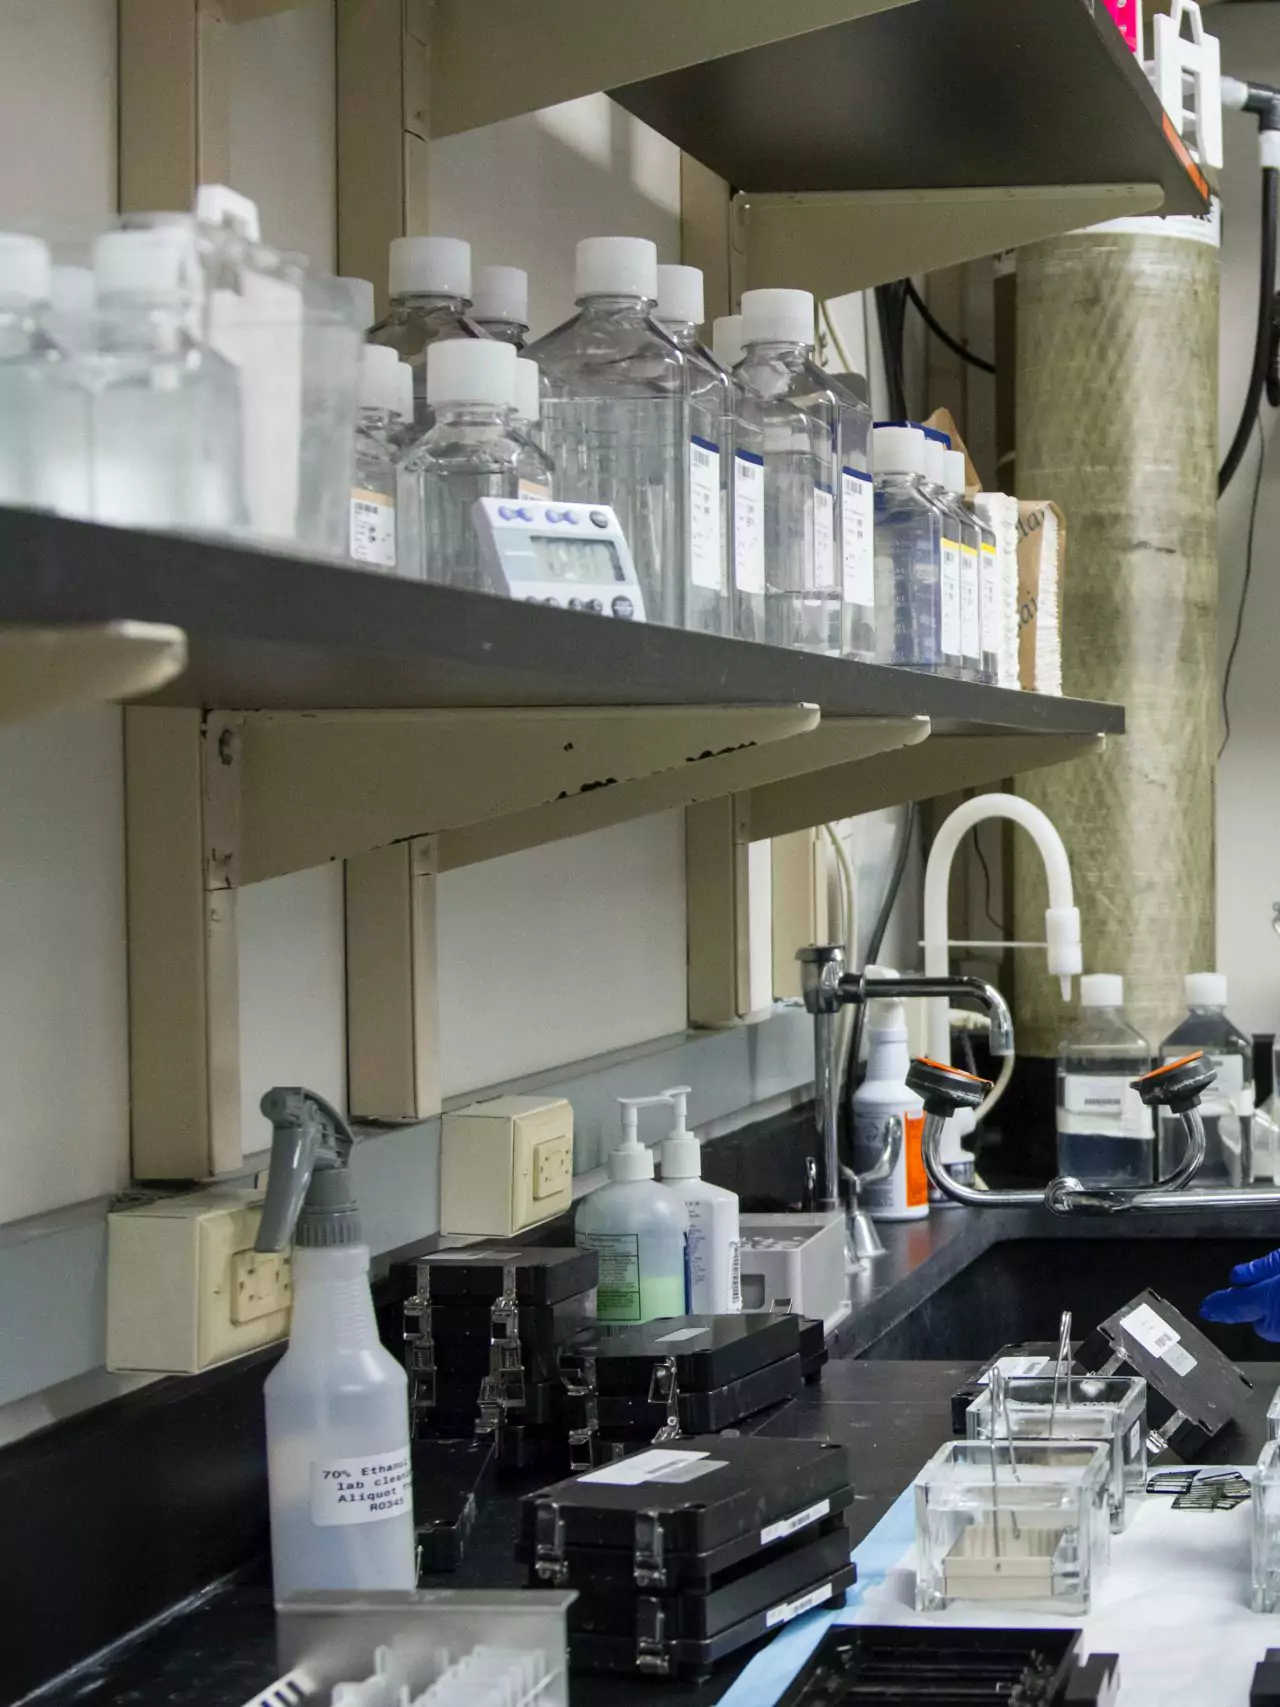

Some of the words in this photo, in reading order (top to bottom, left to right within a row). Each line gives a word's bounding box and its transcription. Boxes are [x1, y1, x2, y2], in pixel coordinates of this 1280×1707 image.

[322, 1470, 351, 1480] 70%
[361, 1457, 408, 1476] Ethanol
[337, 1481, 365, 1491] lab
[338, 1487, 396, 1503] Aliquot
